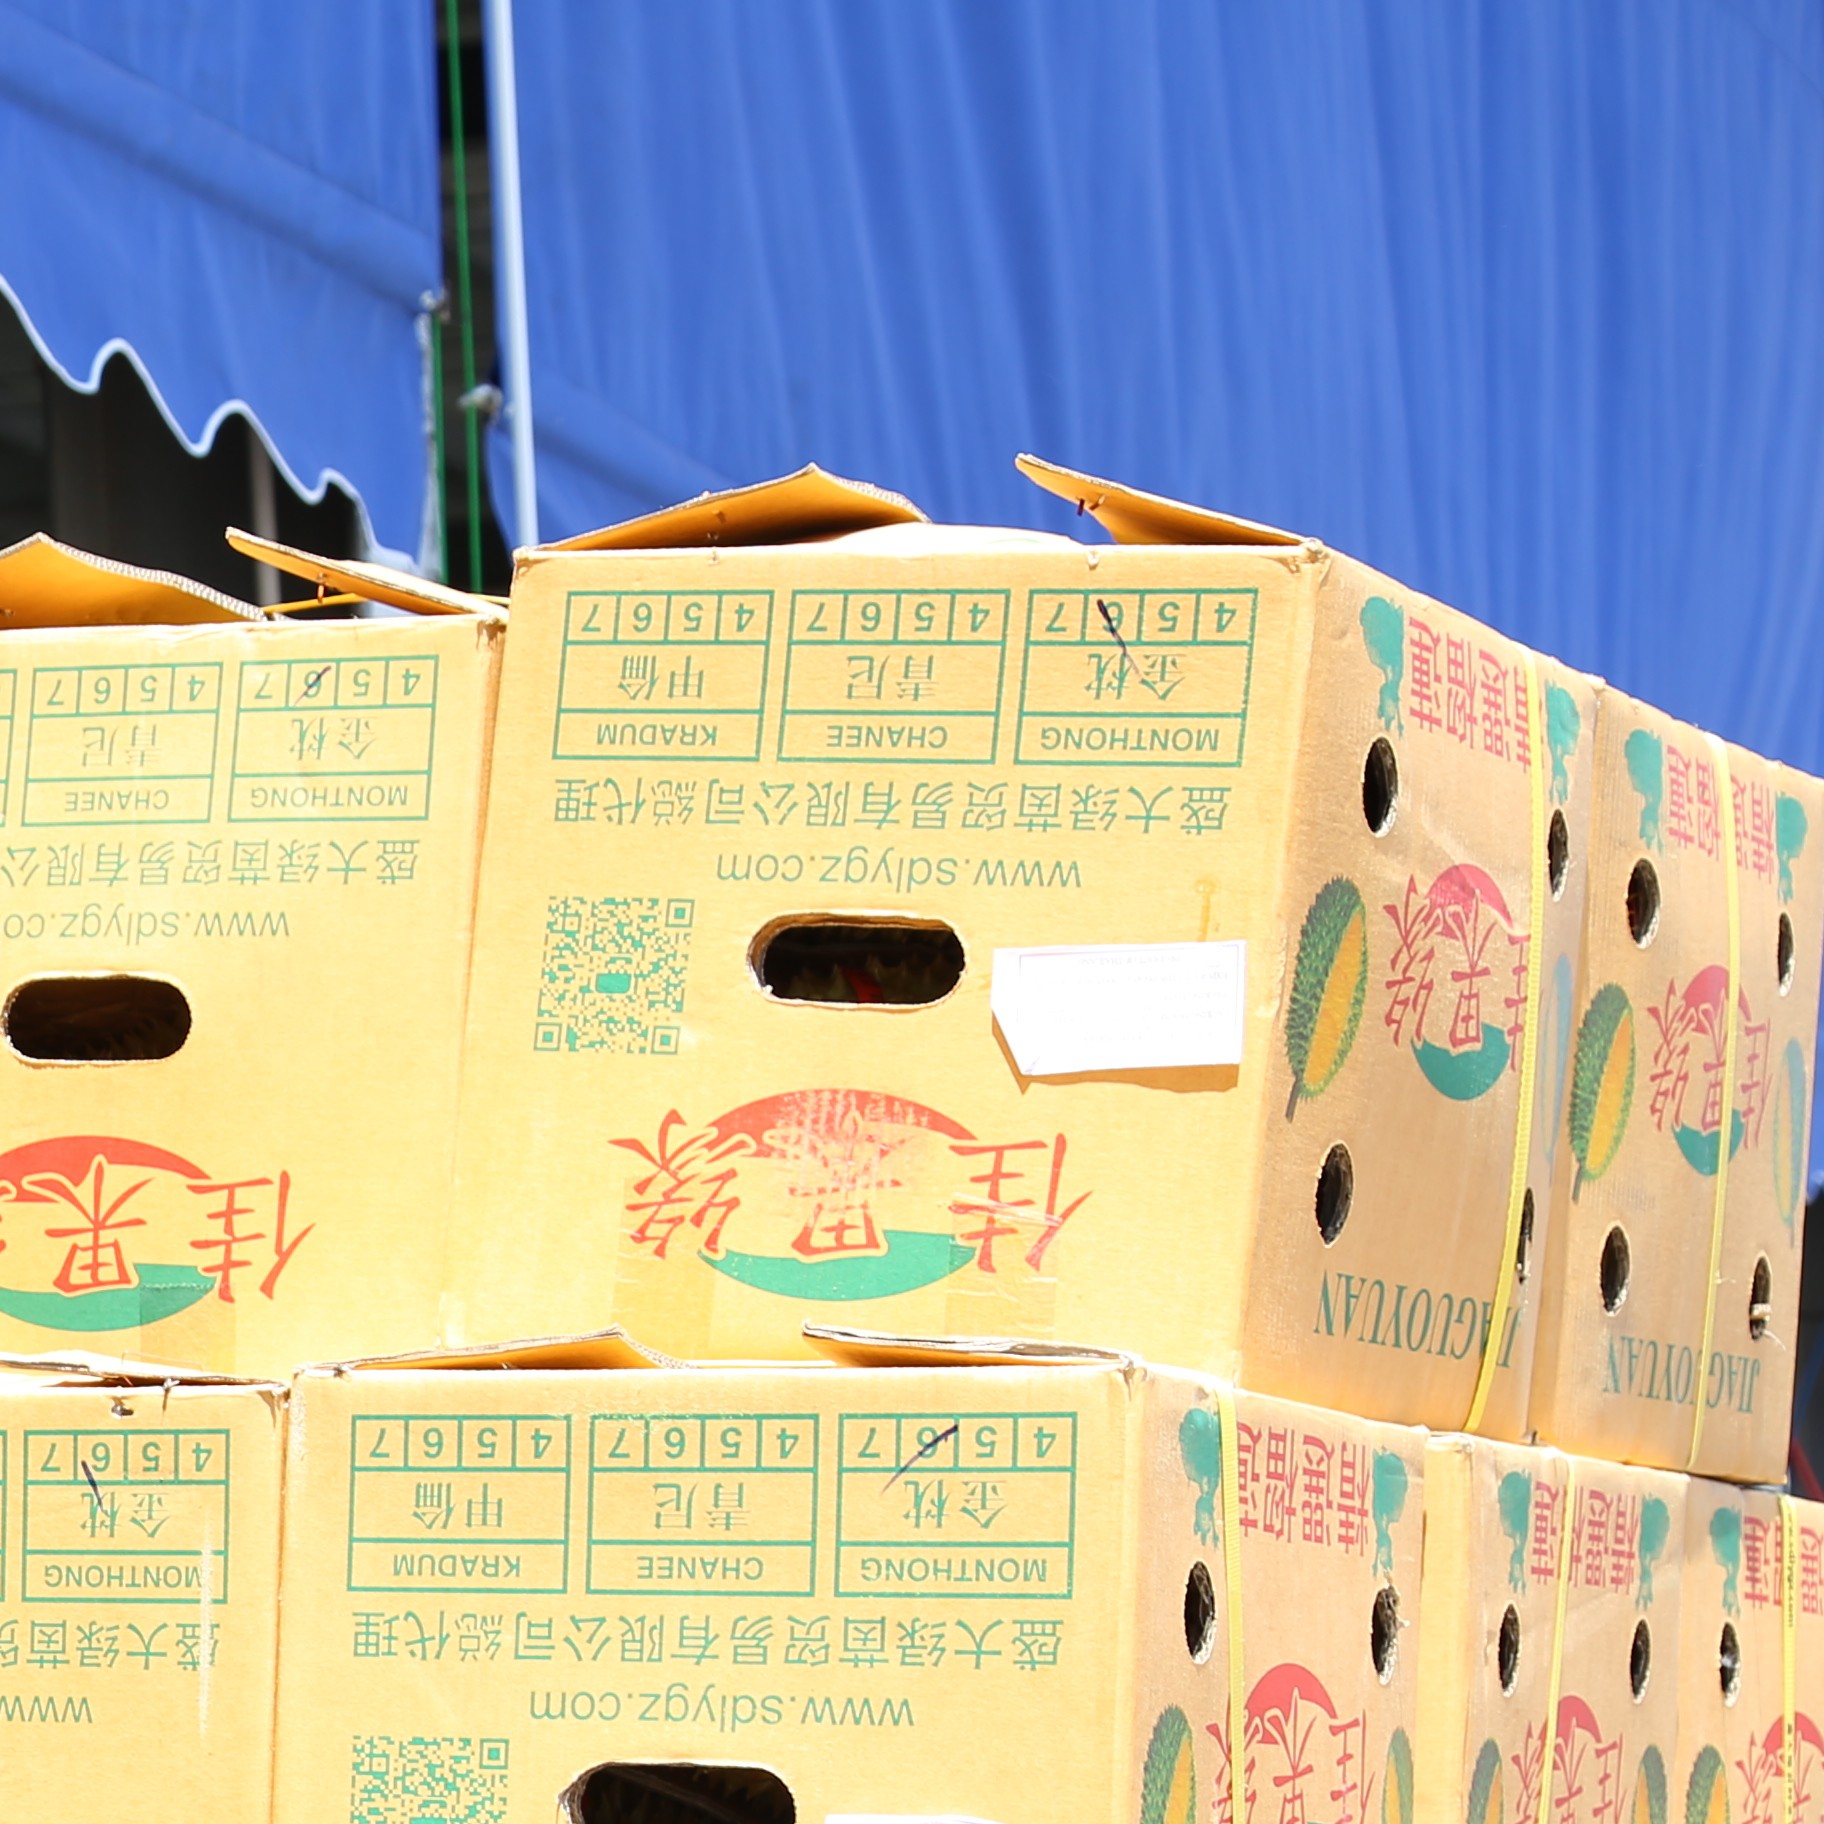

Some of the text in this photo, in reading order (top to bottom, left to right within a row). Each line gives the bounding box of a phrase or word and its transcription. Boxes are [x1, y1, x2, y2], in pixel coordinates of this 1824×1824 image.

[840, 652, 944, 702] 青尼
[1081, 651, 1189, 702] 金枕
[76, 722, 165, 770] 青尼
[287, 715, 378, 763] 金枕
[594, 721, 720, 746] KRADUM
[825, 723, 949, 749] CHANEE
[1037, 725, 1222, 753] MONTHONG
[64, 788, 170, 813] CHANEE
[248, 783, 409, 809] MONTHONG
[714, 844, 1085, 895] www.sdlygz.com
[606, 1110, 1092, 1274] 佳果缘
[1313, 1270, 1522, 1369] JAGUOYUAN
[78, 1490, 172, 1540] 金枕
[649, 1480, 753, 1532] 青尼
[901, 1479, 1008, 1532] 金枕
[43, 1563, 206, 1590] MONTHONG
[390, 1552, 523, 1578] KRADUM
[636, 1554, 765, 1581] CHANEE
[857, 1556, 1047, 1585] MONTHONG
[527, 1680, 916, 1734] www.sdlygz.com
